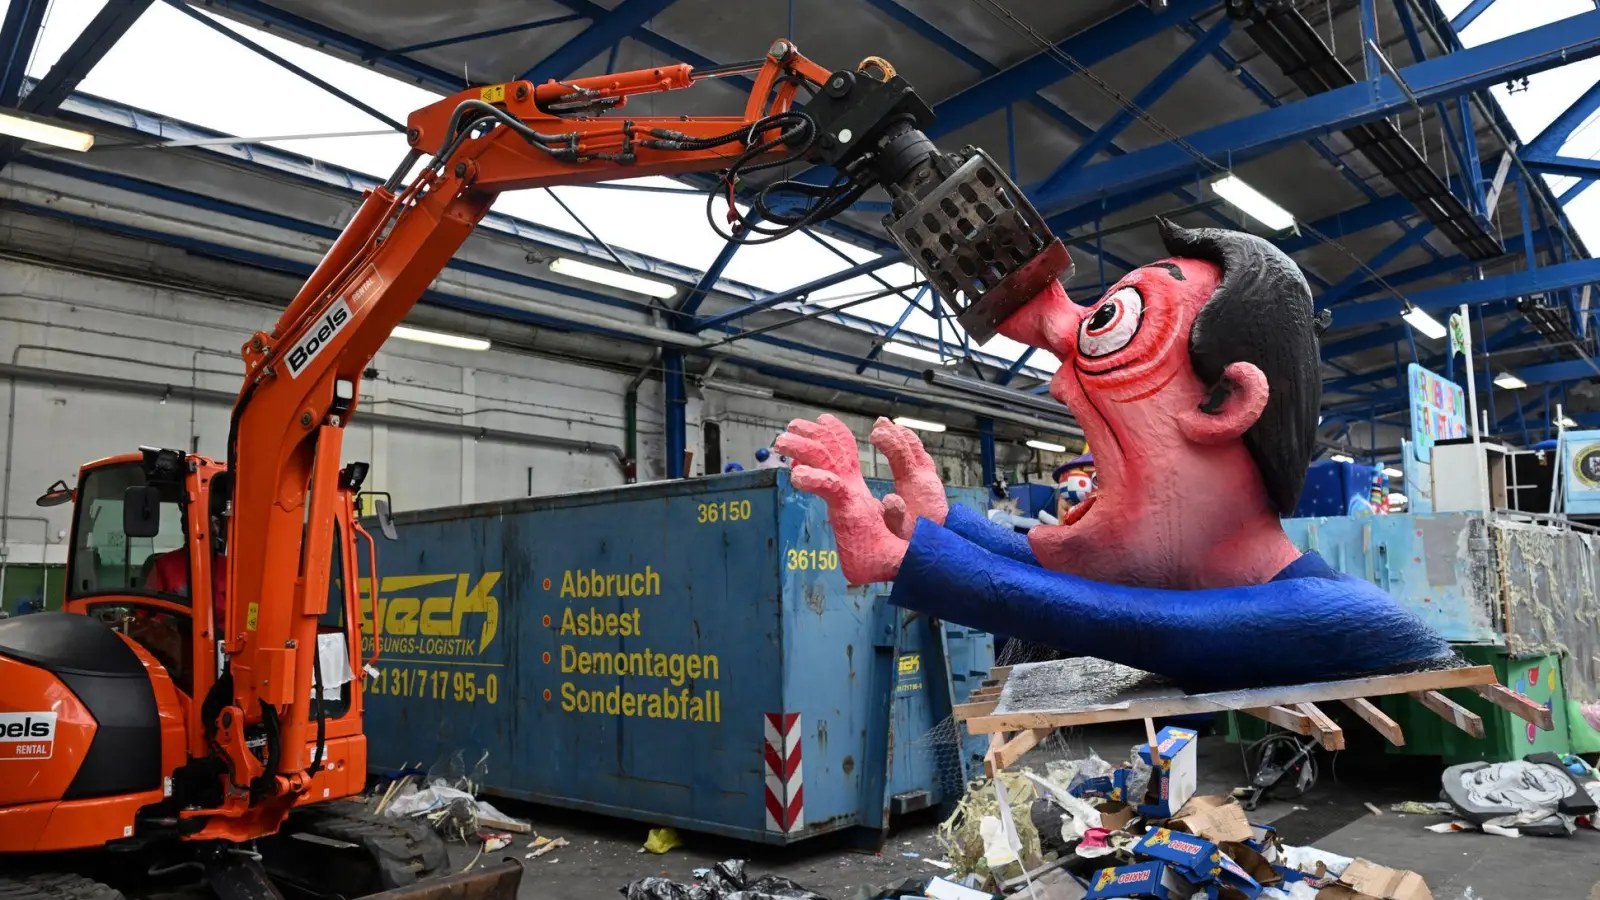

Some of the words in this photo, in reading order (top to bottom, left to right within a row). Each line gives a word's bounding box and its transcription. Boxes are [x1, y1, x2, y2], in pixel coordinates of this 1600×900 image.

[351, 277, 376, 303] RENTAL
[287, 307, 348, 373] Boels
[697, 499, 751, 523] 36150
[787, 548, 838, 571] 36150
[560, 565, 660, 598] Abbruch
[560, 607, 641, 636] Asbest
[361, 636, 476, 656] ORGUNGS-LOGISTIK
[560, 644, 719, 687] Demontagen
[560, 682, 721, 723] Sonderabfall
[16, 744, 47, 755] RENTAL
[1167, 839, 1203, 855] HARIBO
[1117, 869, 1151, 884] HARIBO
